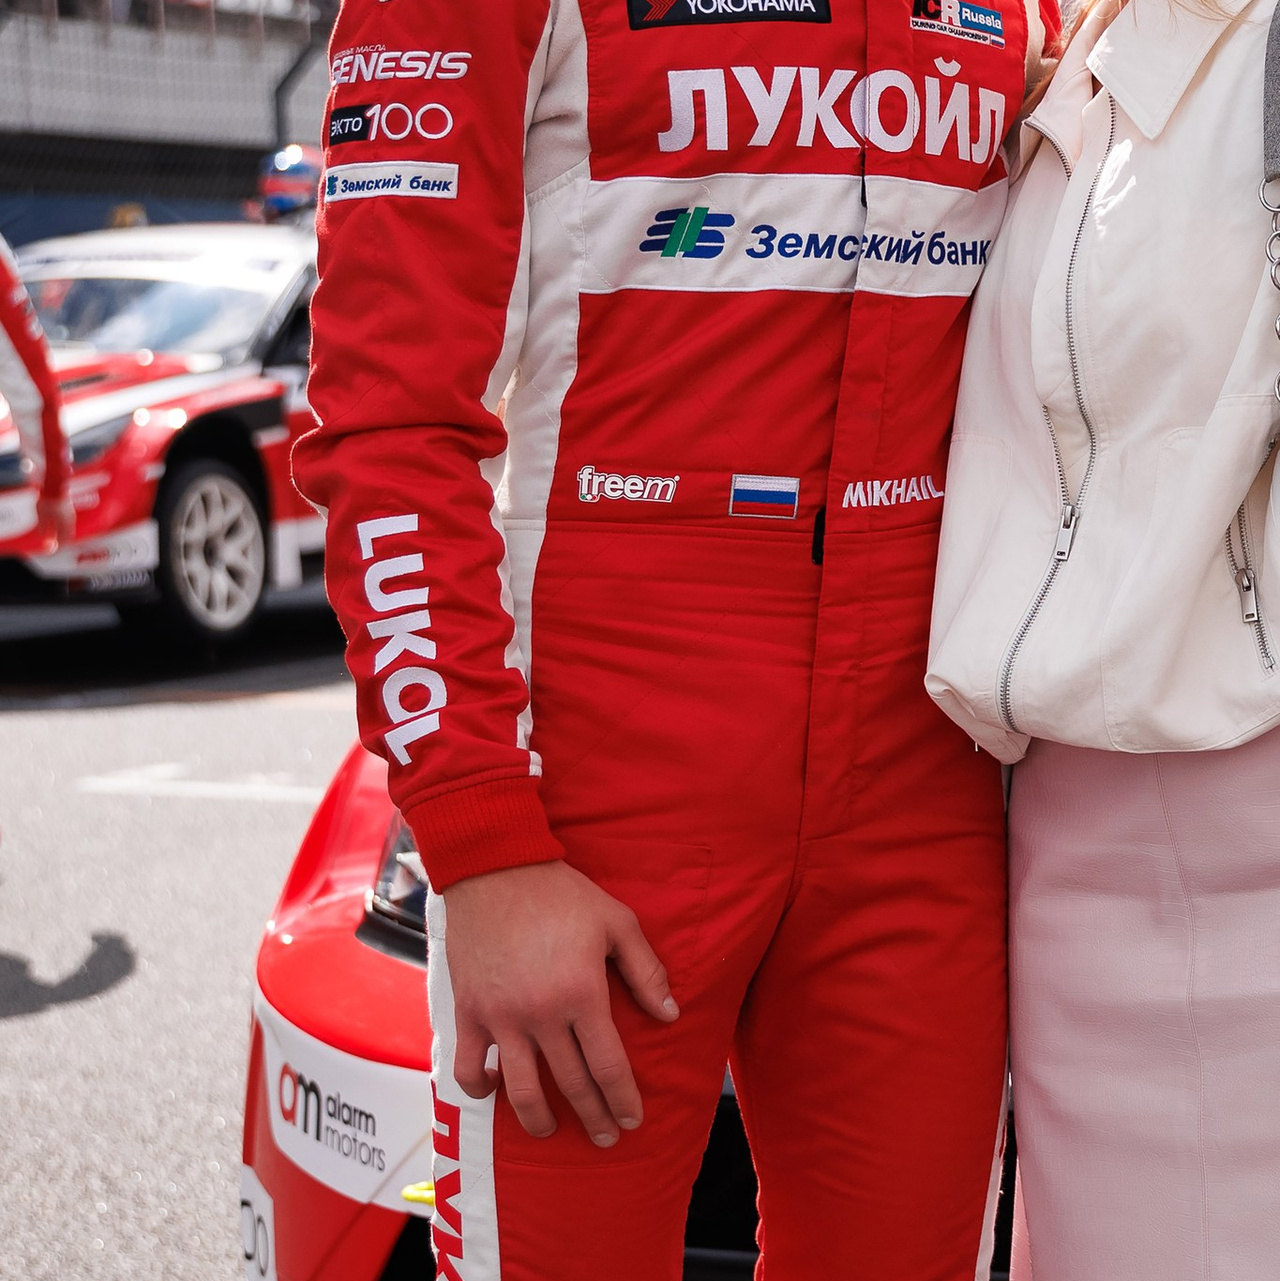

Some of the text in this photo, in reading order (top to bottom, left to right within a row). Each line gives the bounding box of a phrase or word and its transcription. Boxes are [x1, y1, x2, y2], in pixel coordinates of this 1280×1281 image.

[962, 8, 1002, 30] Russia
[332, 51, 472, 85] GENESIS
[366, 103, 453, 142] 100
[657, 57, 1006, 164] ЛУКОЙЛ
[341, 174, 453, 194] Земский банк
[745, 223, 993, 267] Земский банк
[577, 466, 681, 503] freem
[842, 475, 945, 508] MIKHAIL
[326, 1092, 377, 1137] alarm
[325, 1124, 387, 1172] motors
